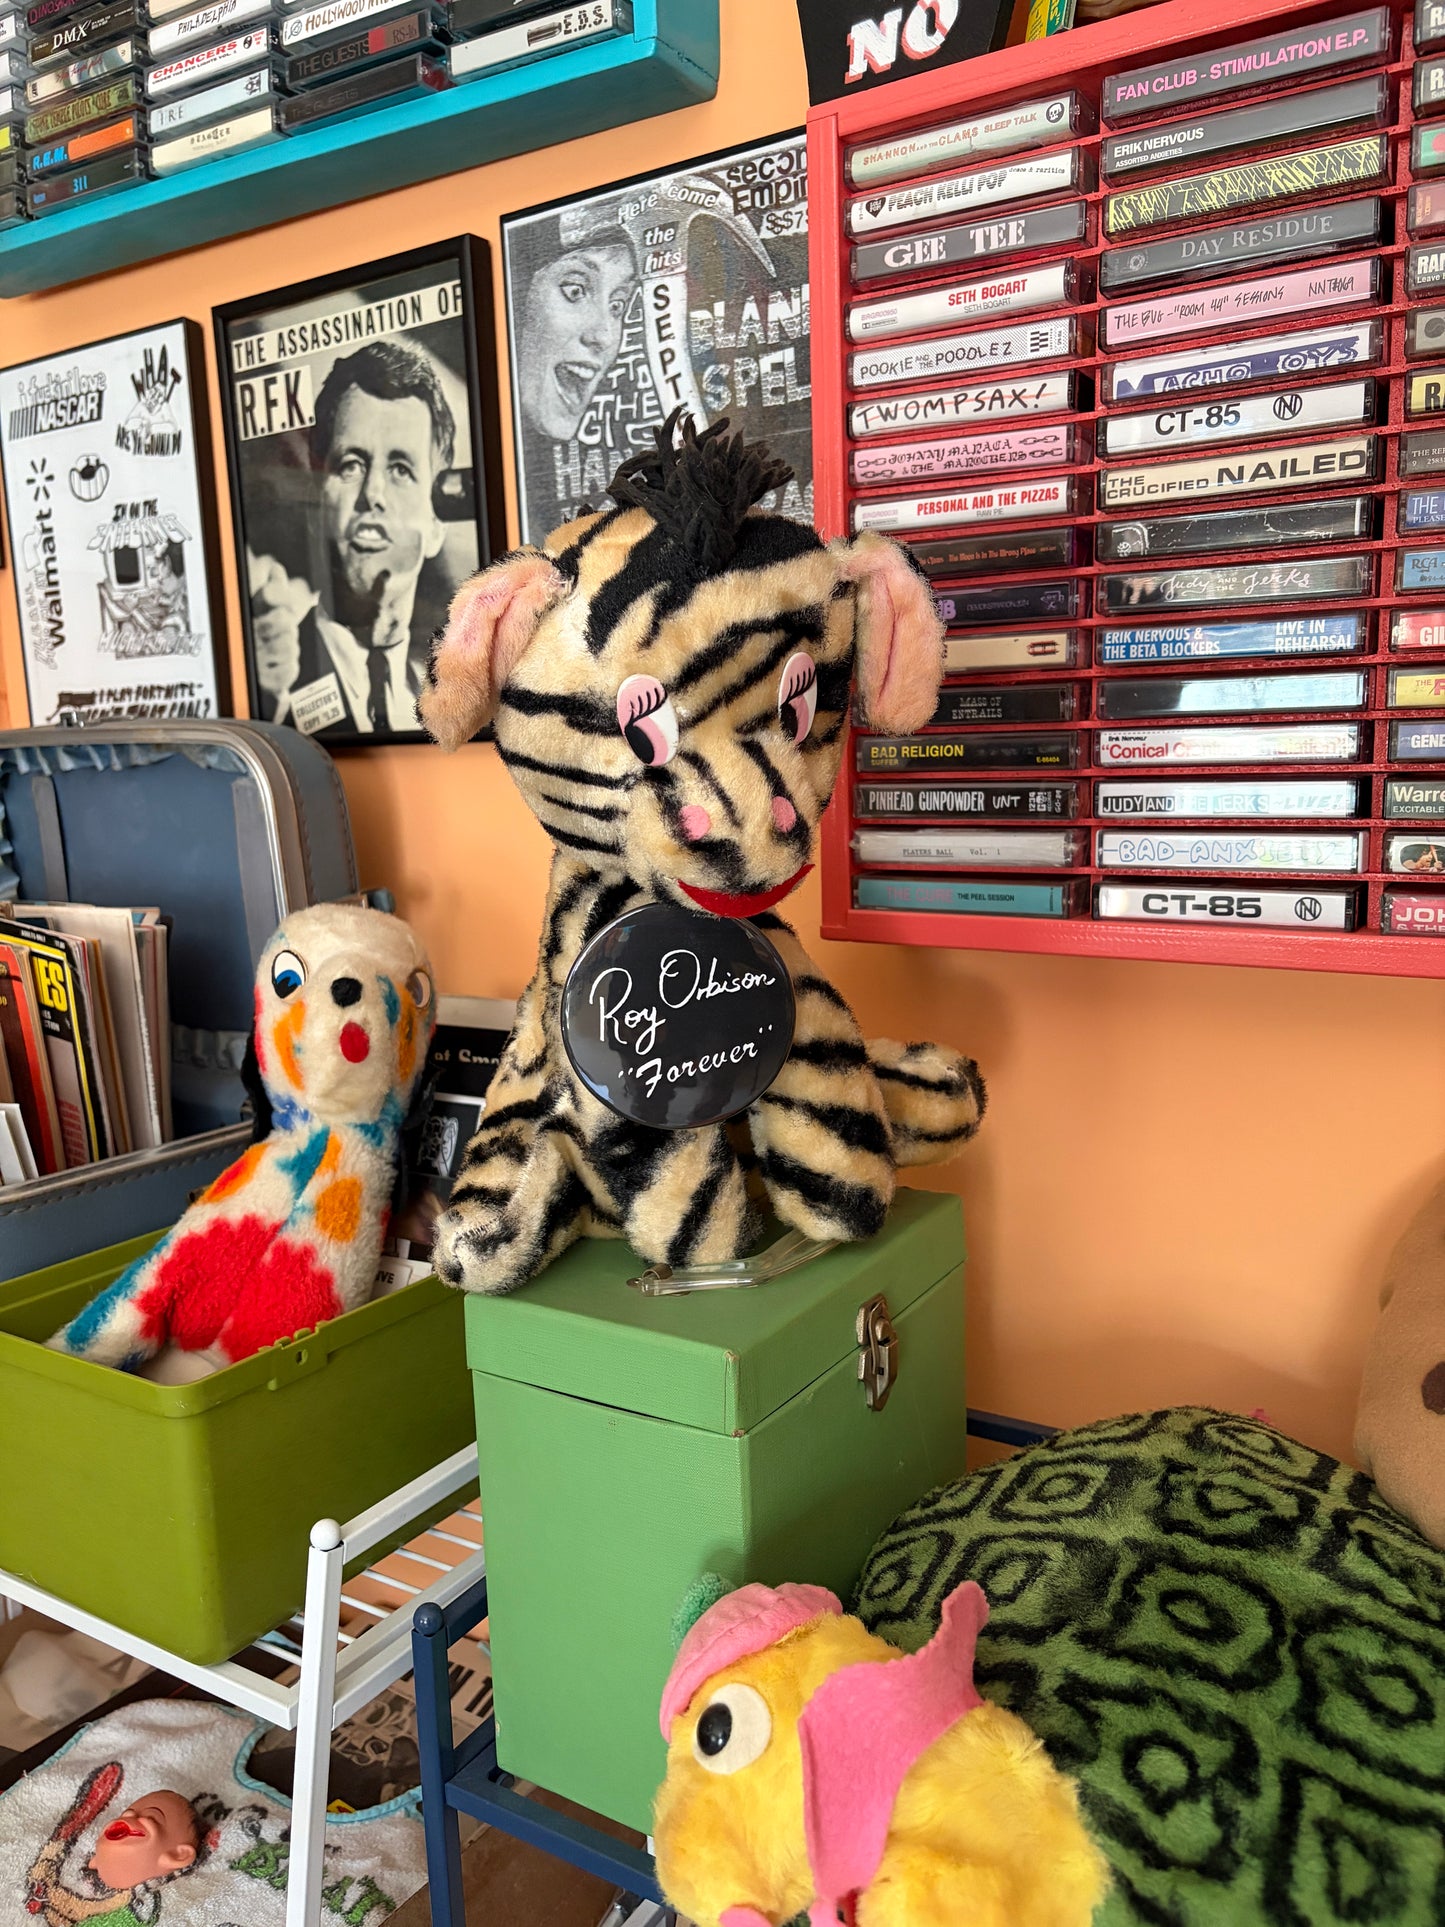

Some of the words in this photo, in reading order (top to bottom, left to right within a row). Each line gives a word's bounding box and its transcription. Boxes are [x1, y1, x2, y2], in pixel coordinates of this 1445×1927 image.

[51, 20, 91, 51] DMX
[845, 0, 958, 84] NO
[153, 41, 237, 79] CHANCERS
[297, 59, 321, 76] THE
[1116, 81, 1149, 102] FAN
[1152, 70, 1198, 94] CLUB
[1209, 36, 1331, 80] STIMULATION
[1335, 28, 1369, 51] E.P.
[863, 143, 916, 166] SHANNON
[938, 127, 979, 146] CLAMS
[984, 119, 1012, 133] SLEEP
[1014, 112, 1037, 126] TALK
[1114, 141, 1142, 158] ERIK
[1143, 127, 1204, 151] NERVOUS
[33, 146, 67, 171] R.E.M.
[1115, 155, 1149, 168] ASSORTED
[73, 175, 88, 193] 311
[888, 187, 934, 212] PEACH
[937, 177, 974, 201] KELLI
[978, 170, 1007, 192] POP
[618, 190, 658, 224] Here
[667, 184, 717, 208] come
[644, 227, 675, 247] the
[884, 236, 946, 267] GEE
[970, 220, 1026, 254] TEE
[1181, 238, 1224, 258] DAY
[1232, 215, 1333, 249] RESIDUE
[645, 250, 682, 273] hits
[1417, 274, 1440, 284] Leave
[948, 289, 976, 306] SETH
[982, 279, 1027, 300] BOGART
[964, 301, 982, 314] SETH
[983, 298, 1011, 311] BOGART
[1115, 312, 1138, 330] THE
[1141, 309, 1163, 326] BUG
[1235, 286, 1285, 307] SESSIONS
[235, 337, 266, 369] THE
[278, 293, 423, 359] ASSASSINATION
[438, 284, 463, 317] OF
[915, 355, 930, 363] AND
[919, 360, 934, 369] THE
[936, 342, 1011, 366] POODLEZ
[861, 357, 913, 379] POOKIE
[36, 391, 100, 432] NASCAR
[239, 370, 315, 439] R.F.K.
[591, 392, 662, 422] THE
[856, 383, 1048, 429] TWOMPSAX!
[1156, 403, 1241, 436] CT-85
[1412, 448, 1430, 458] THE
[911, 463, 934, 474] THE
[1107, 478, 1209, 500] CRUCIFIED
[1217, 450, 1366, 487] NAILED
[1109, 475, 1145, 488] THE
[917, 498, 968, 516] PERSONAL
[972, 495, 993, 510] AND
[998, 492, 1016, 507] THE
[1021, 487, 1059, 503] PIZZAS
[976, 509, 992, 518] RAW
[993, 508, 1004, 517] PIE
[1413, 496, 1439, 515] THE
[1412, 557, 1437, 572] RCA
[37, 507, 66, 648] Walmart
[1160, 572, 1210, 600] Judy
[1243, 569, 1310, 594] Jerks
[1105, 631, 1132, 644] ERIK
[1136, 628, 1190, 642] NERVOUS
[1193, 626, 1203, 639] &
[1276, 620, 1304, 635] LIVE
[1309, 619, 1325, 634] IN
[1105, 646, 1127, 659] THE
[1130, 644, 1157, 658] BETA
[1161, 641, 1220, 658] BLOCKERS
[952, 708, 1002, 719] ENTRAILS
[960, 698, 987, 708] MASS
[990, 697, 1002, 707] OF
[871, 746, 897, 759] BAD
[901, 745, 964, 759] RELIGION
[1101, 742, 1169, 759] "Conical
[869, 791, 914, 813] PINHEAD
[918, 791, 985, 812] GUNPOWDER
[1103, 797, 1142, 812] JUDY
[1146, 797, 1174, 812] AND
[1393, 806, 1444, 814] EXCITABLE
[902, 849, 932, 858] PLAYERS
[936, 849, 953, 858] BALL
[970, 849, 987, 857] Vol.
[886, 886, 912, 902] THE
[958, 892, 969, 900] THE
[970, 893, 986, 901] PEEL
[987, 894, 1015, 902] SESSION
[1142, 893, 1262, 918] CT-85
[589, 967, 666, 1056] Roy
[659, 949, 776, 1009] Orbison
[618, 1024, 774, 1099] "Forever"
